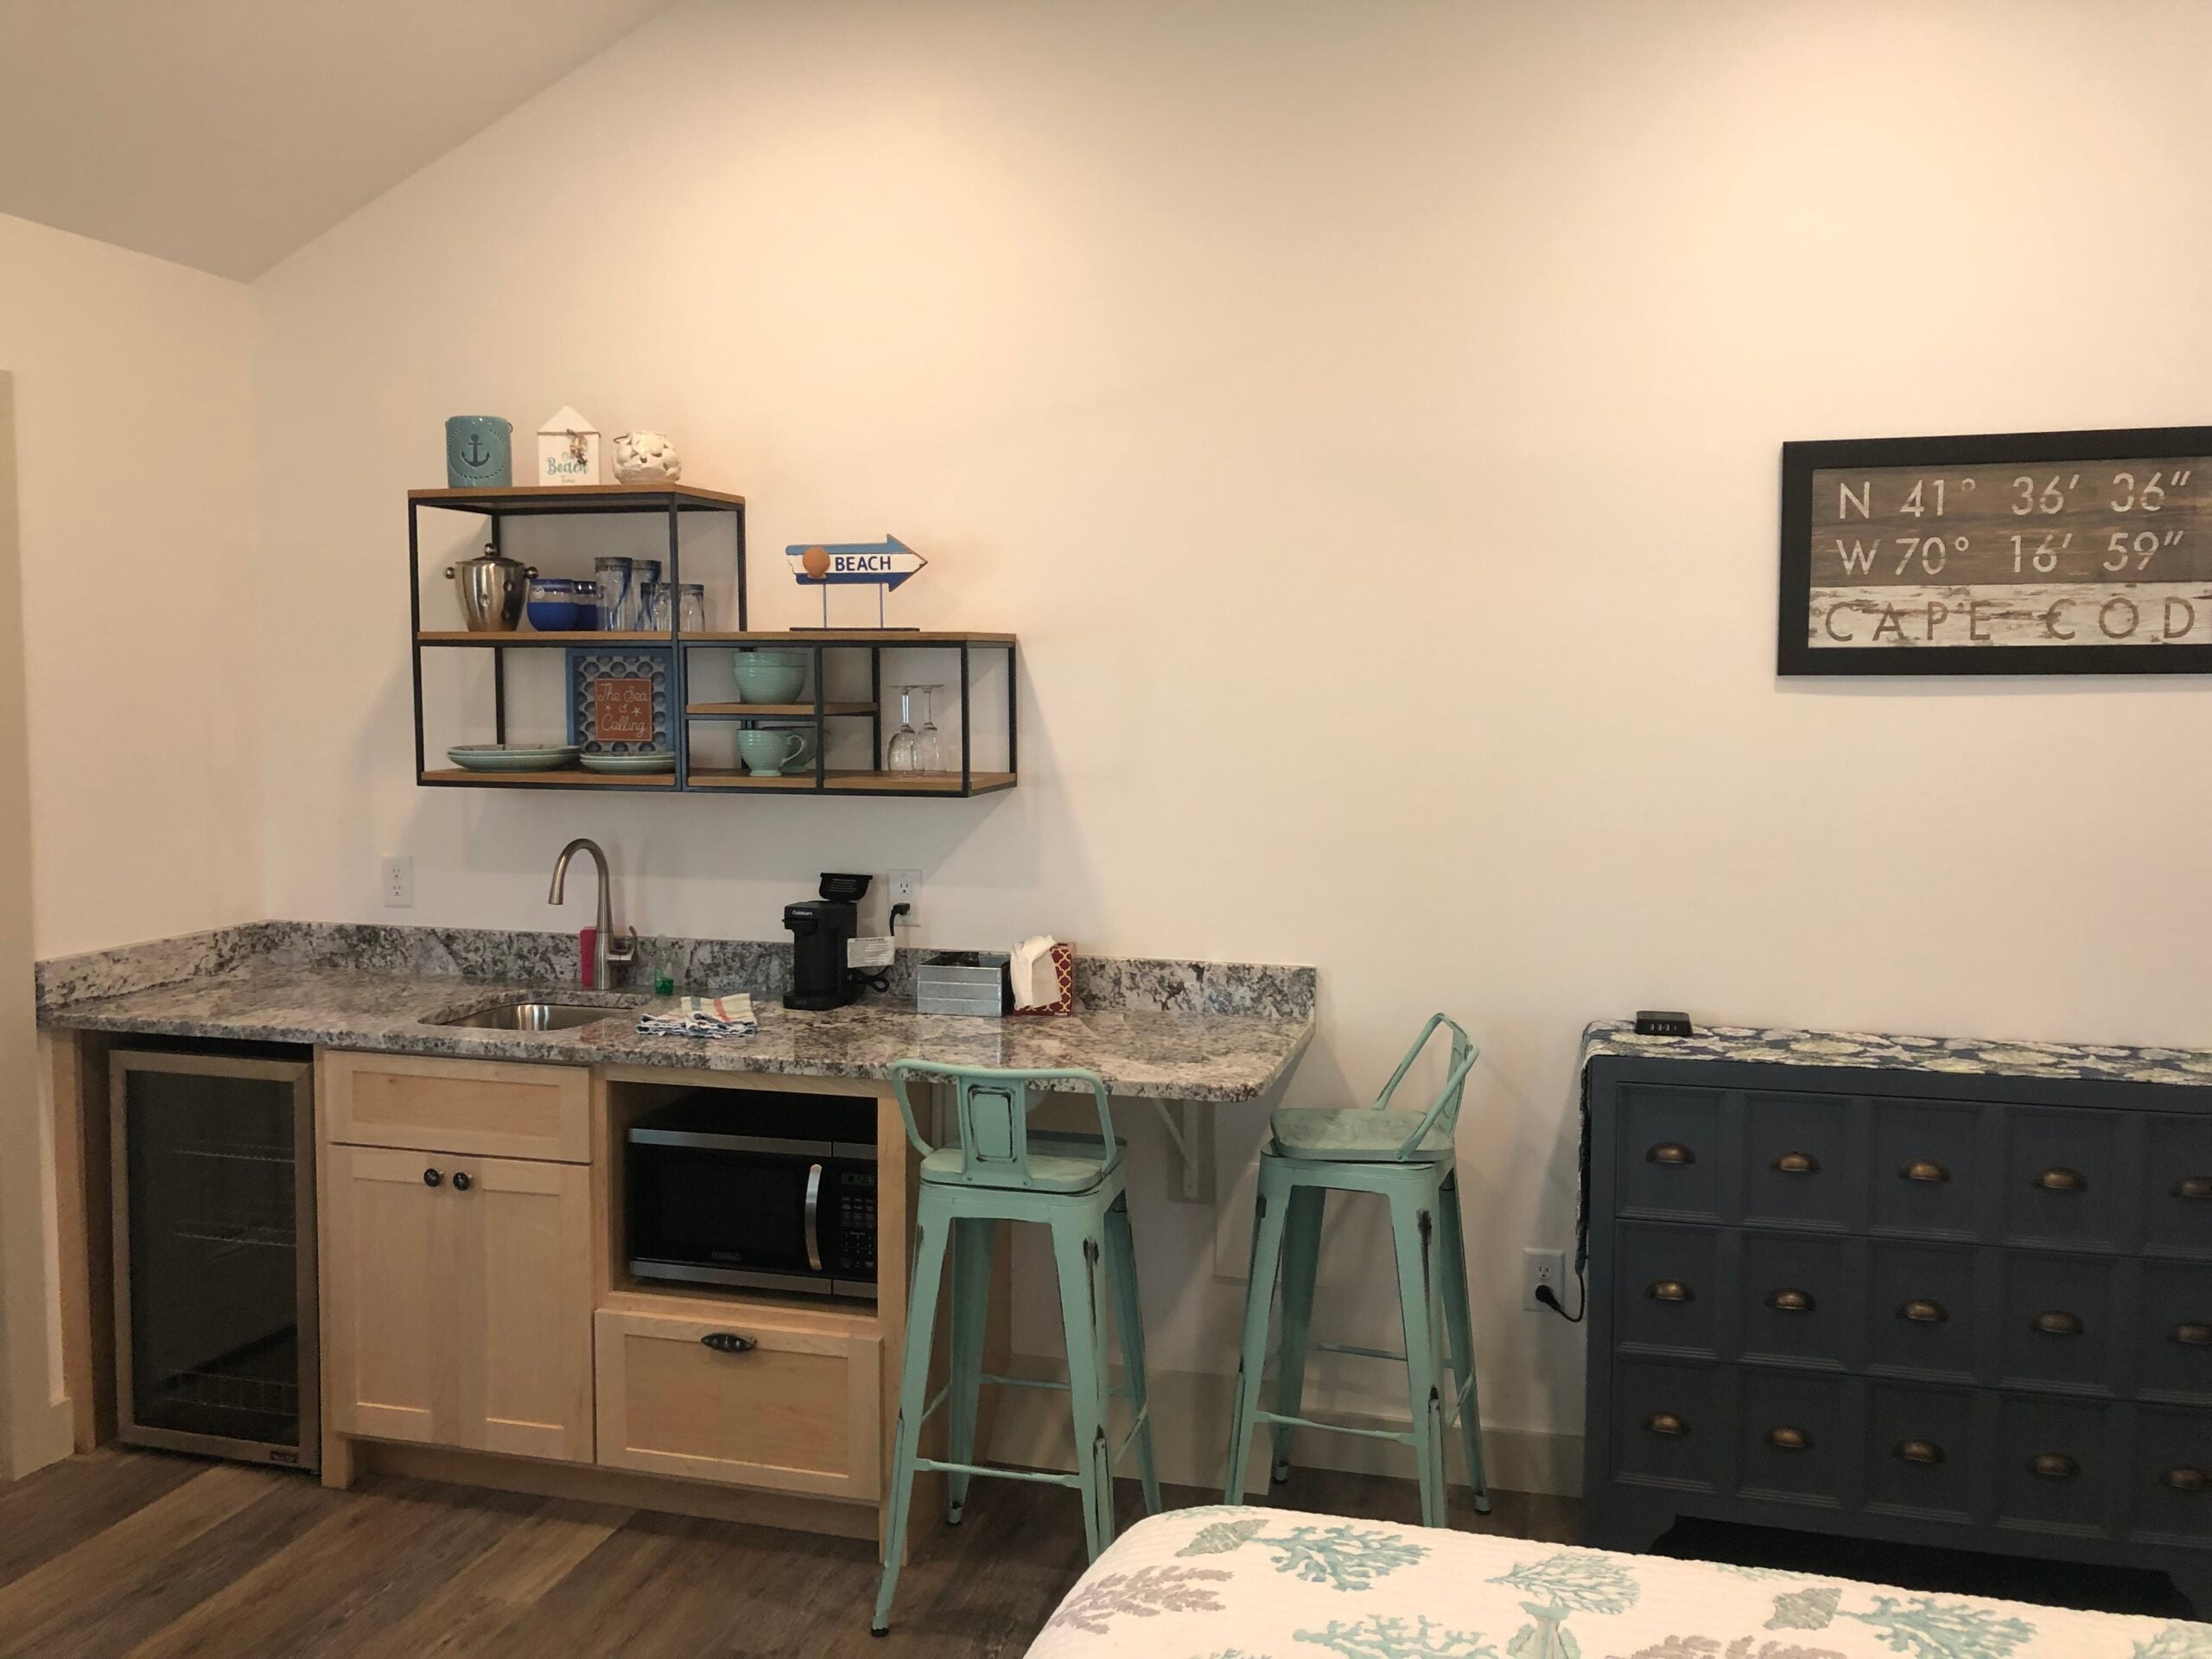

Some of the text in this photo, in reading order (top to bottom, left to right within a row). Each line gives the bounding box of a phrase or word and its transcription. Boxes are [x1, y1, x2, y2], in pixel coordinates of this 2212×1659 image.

[1839, 481, 1870, 519] N
[834, 556, 892, 572] BEACH
[1835, 538, 1881, 576] W
[1824, 596, 2196, 643] CAPE COD
[597, 682, 649, 703] The Sea
[618, 703, 628, 714] is
[601, 713, 646, 739] Calling
